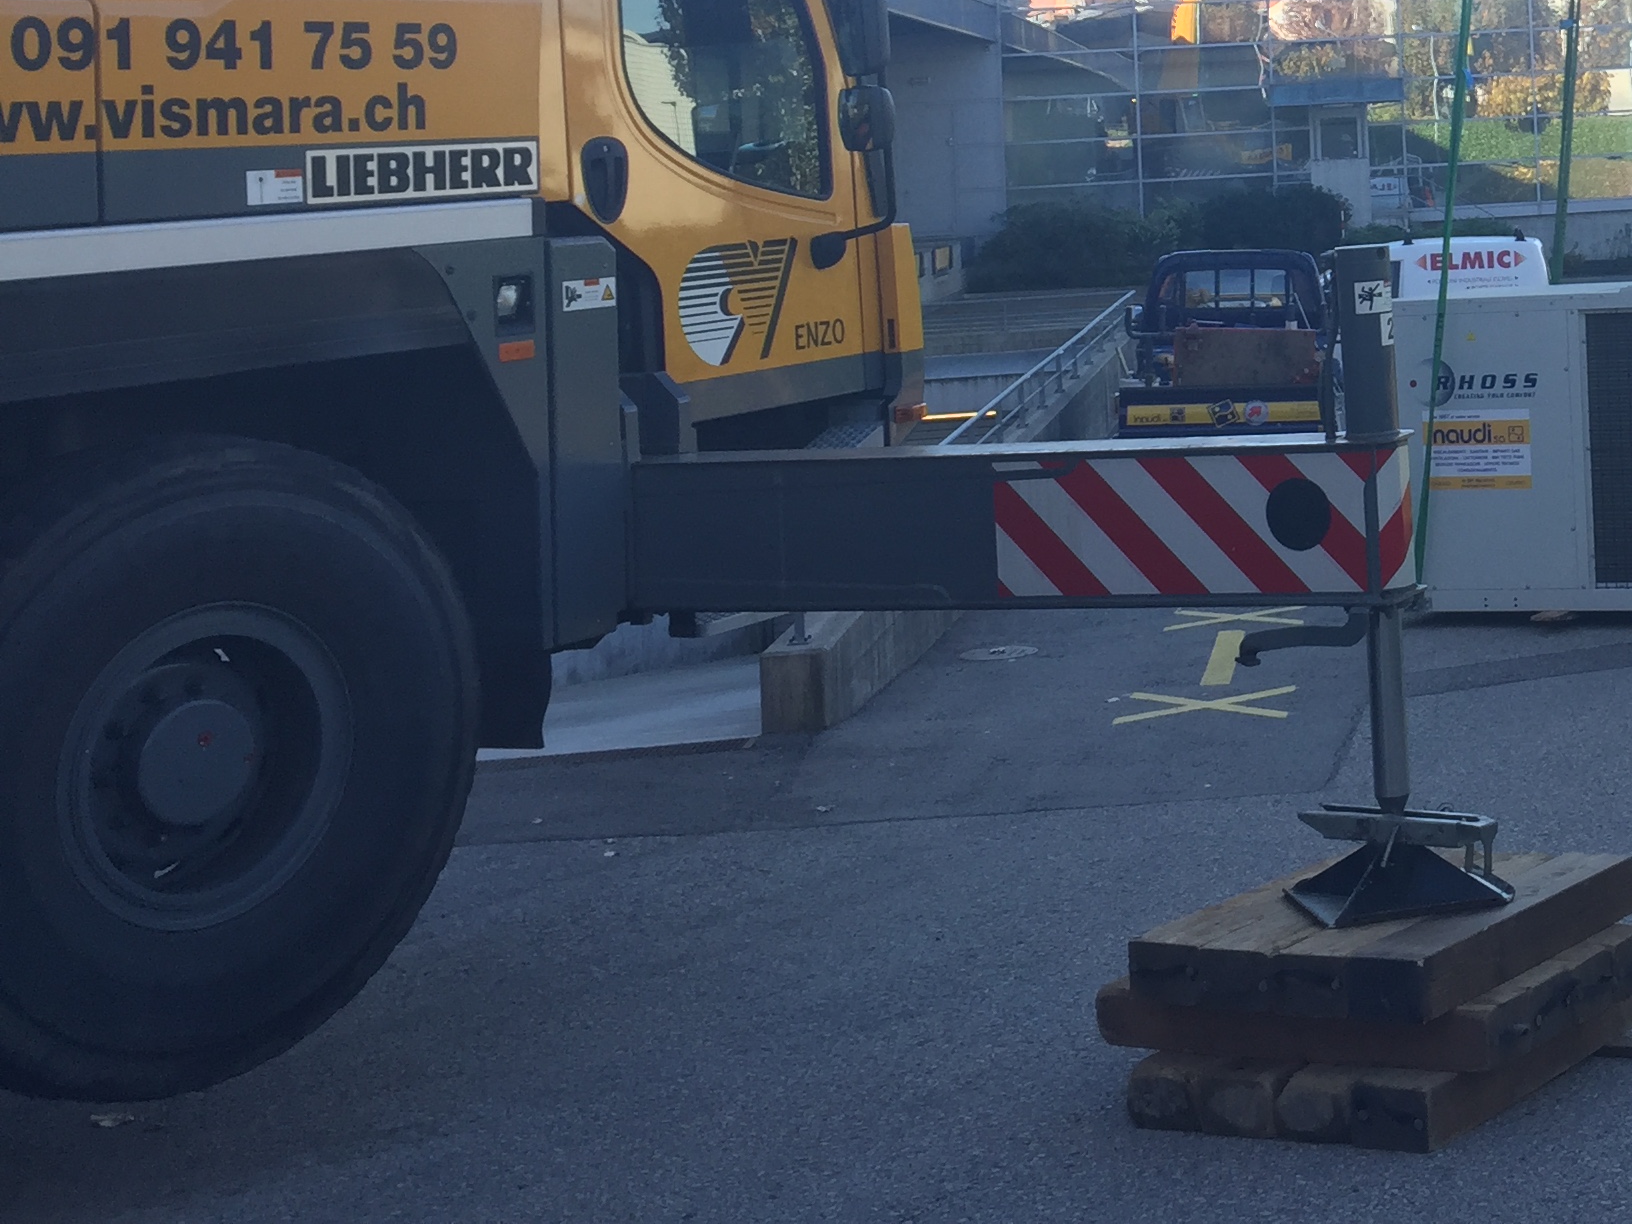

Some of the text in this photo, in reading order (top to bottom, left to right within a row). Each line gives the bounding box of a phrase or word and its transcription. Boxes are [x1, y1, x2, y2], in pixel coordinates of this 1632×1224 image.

[11, 16, 457, 71] 091 941 75 59
[310, 146, 533, 199] LIEBHERR
[1430, 249, 1512, 271] ELMIC
[795, 318, 845, 350] ENZO
[1437, 372, 1538, 391] RHOSS
[1433, 422, 1492, 444] naudi
